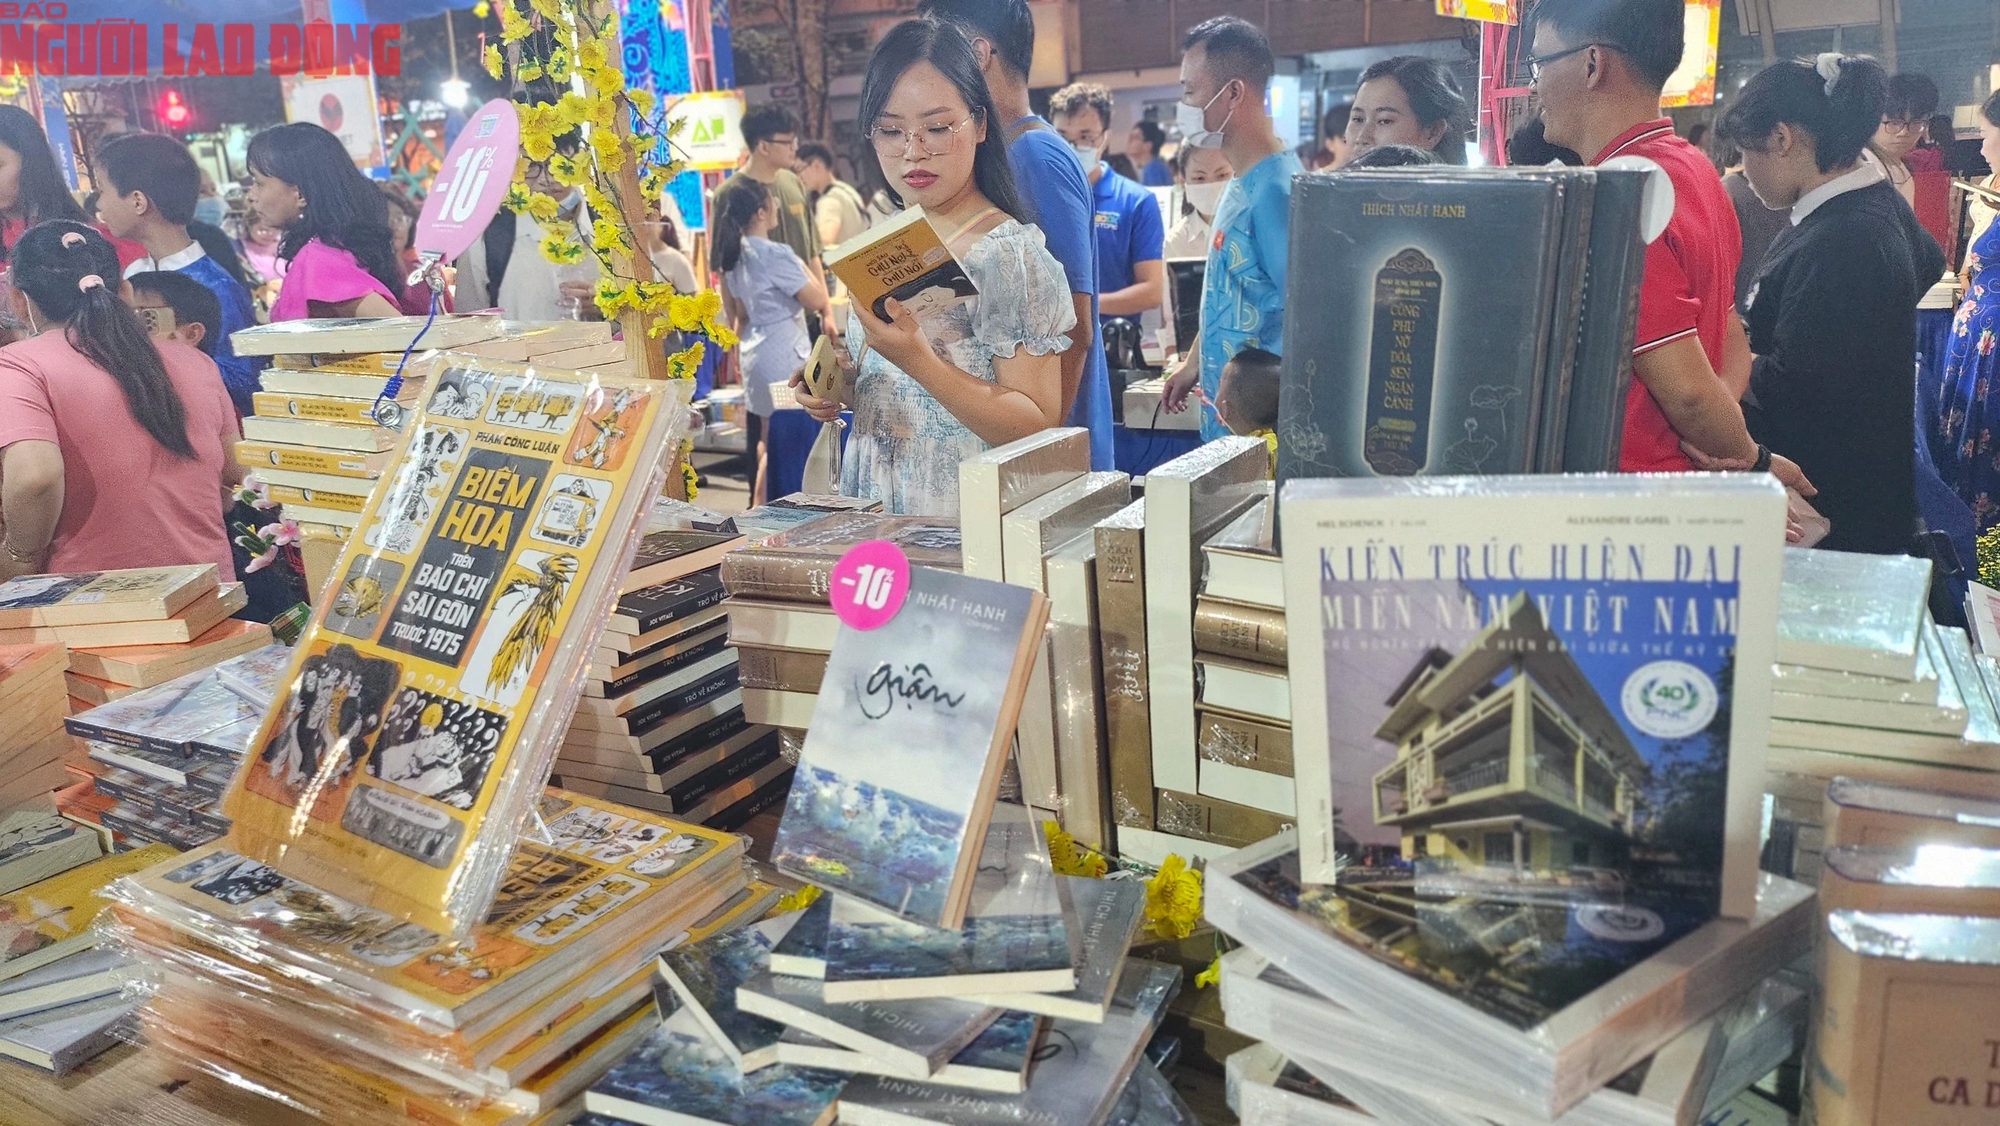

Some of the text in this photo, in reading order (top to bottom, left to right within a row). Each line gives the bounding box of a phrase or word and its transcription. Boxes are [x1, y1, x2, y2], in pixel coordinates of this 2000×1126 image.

[503, 435, 531, 449] CÔNG
[531, 440, 561, 455] LUẬN
[457, 464, 538, 509] BIẾM
[438, 500, 514, 553] HỌA
[1566, 515, 1670, 526] ALEXANDRE GAREL
[450, 552, 475, 569] TRÊN
[1319, 537, 1404, 581] KIẾN
[1428, 536, 1523, 580] TRÚC
[1550, 536, 1645, 587] HIỆN
[414, 560, 495, 600] BÁO CHÍ
[840, 563, 896, 610] -10%
[401, 590, 476, 629] SÀI GÒN
[916, 590, 957, 612] NHẤT
[961, 601, 1007, 623] HẠNH
[1436, 593, 1511, 630] NAM
[1537, 588, 1629, 637] VIỆT
[1653, 596, 1738, 636] NAM
[391, 621, 464, 656] TRƯỚC 1975
[1656, 685, 1685, 701] 40
[872, 1007, 926, 1035] THÍCH
[1928, 1076, 1971, 1107] CA
